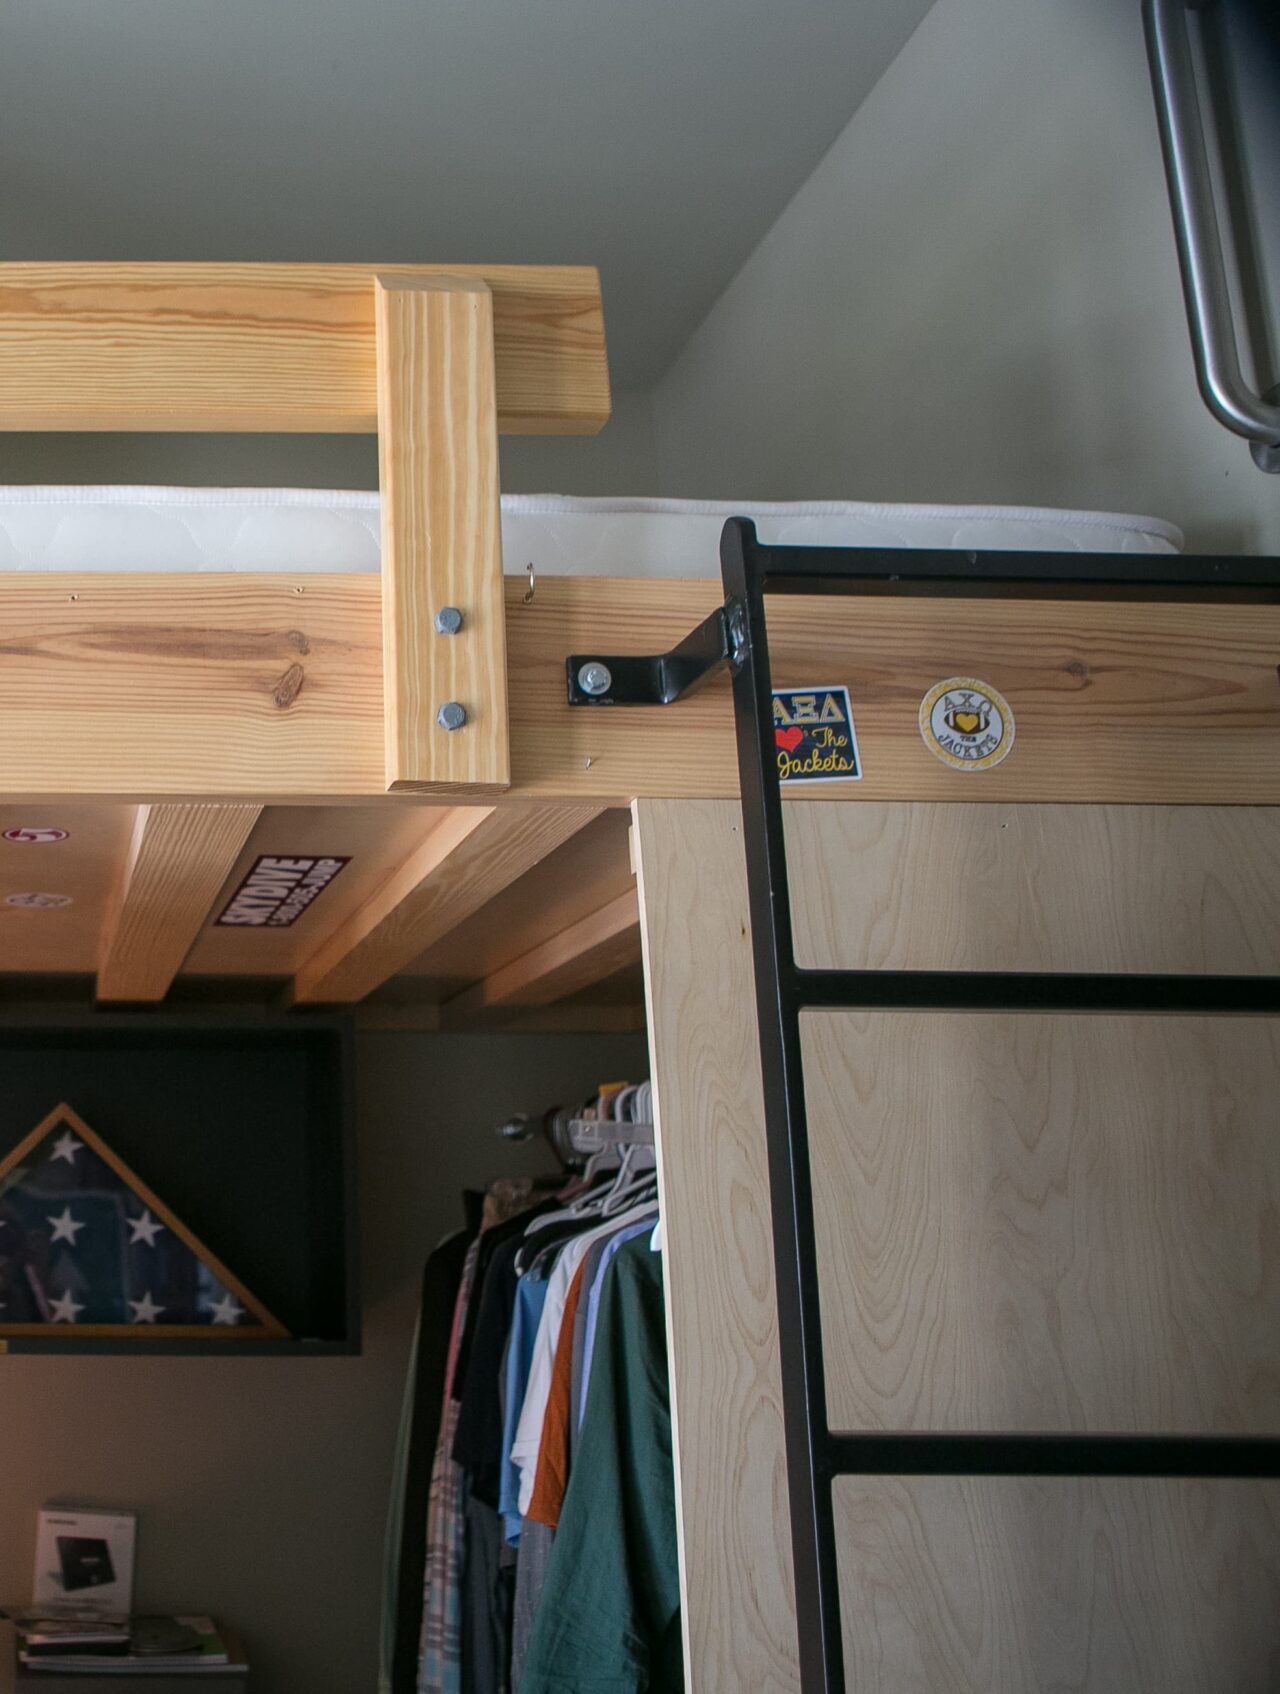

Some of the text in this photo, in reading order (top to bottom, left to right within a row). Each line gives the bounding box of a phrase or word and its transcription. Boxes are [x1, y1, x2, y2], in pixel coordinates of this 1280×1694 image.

[811, 726, 848, 748] The
[938, 733, 999, 758] JACKETS
[777, 748, 855, 780] Jackets
[220, 857, 315, 926] SKYDIVE
